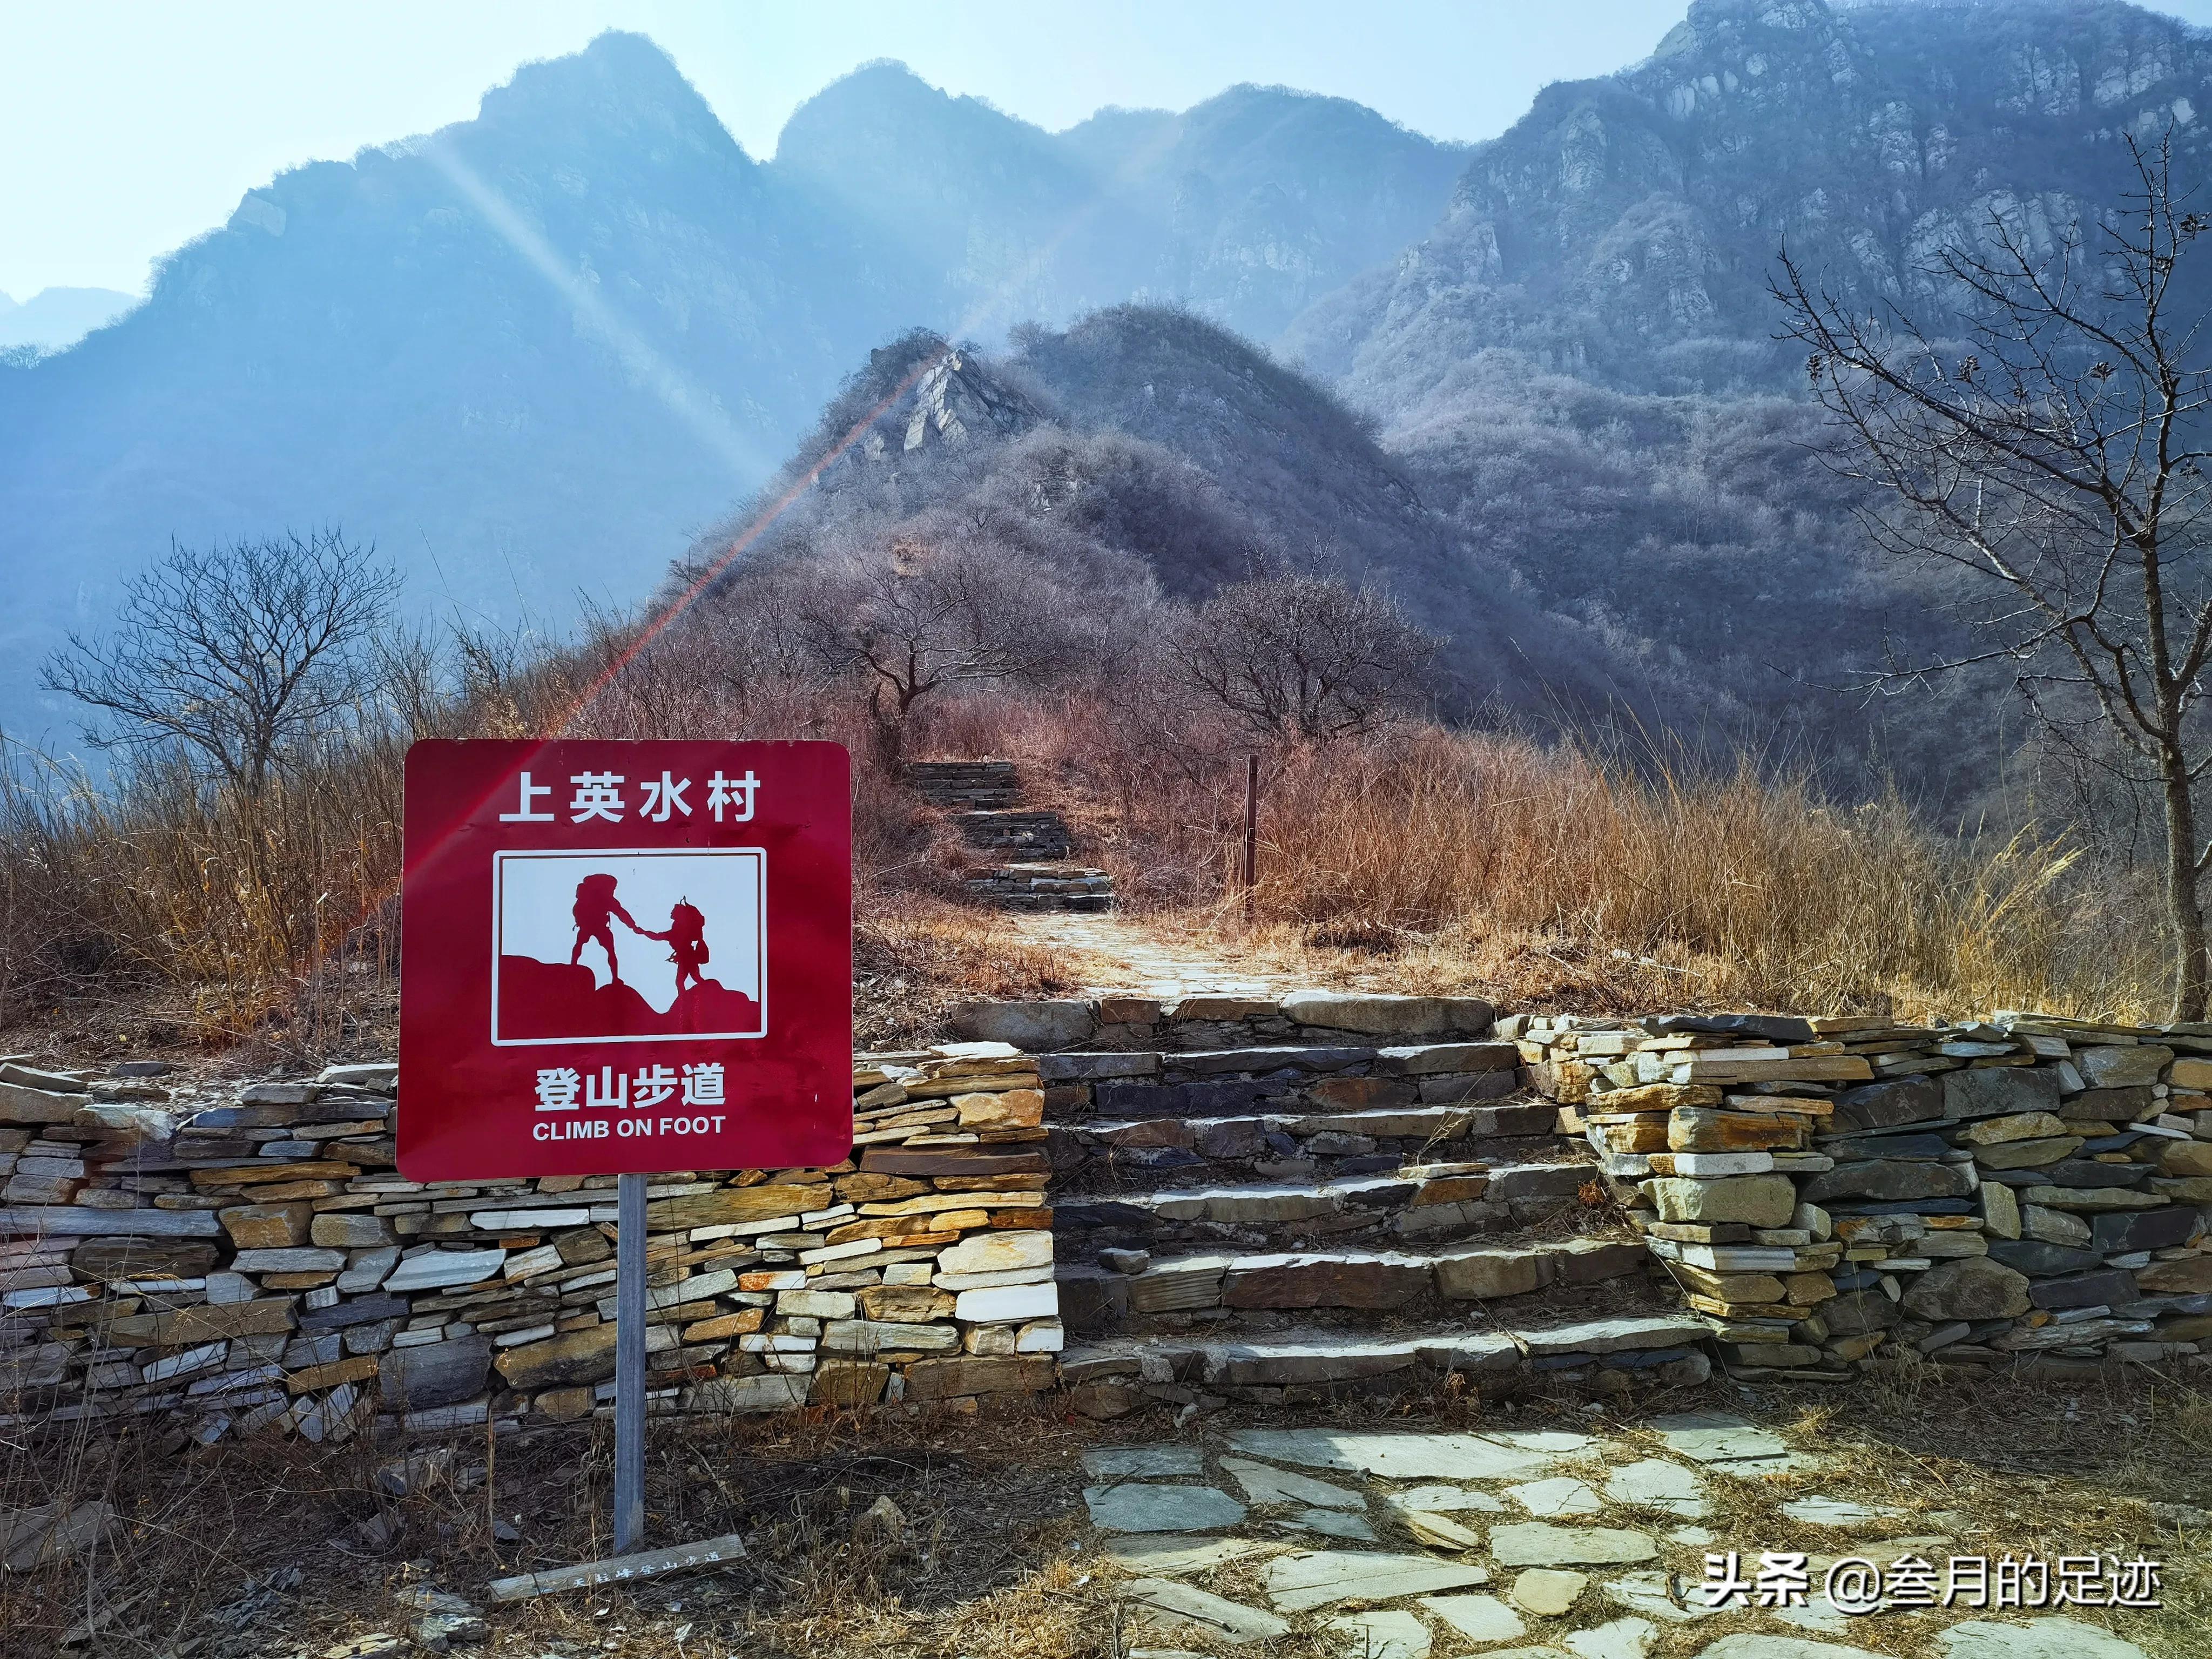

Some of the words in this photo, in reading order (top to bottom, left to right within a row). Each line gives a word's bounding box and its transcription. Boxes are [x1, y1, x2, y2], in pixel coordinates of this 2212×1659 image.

[498, 771, 761, 824] 上英水村
[534, 1062, 726, 1111] 登山步道
[532, 1120, 609, 1141] CLIMB
[616, 1118, 652, 1137] ON
[659, 1116, 726, 1136] FOOT
